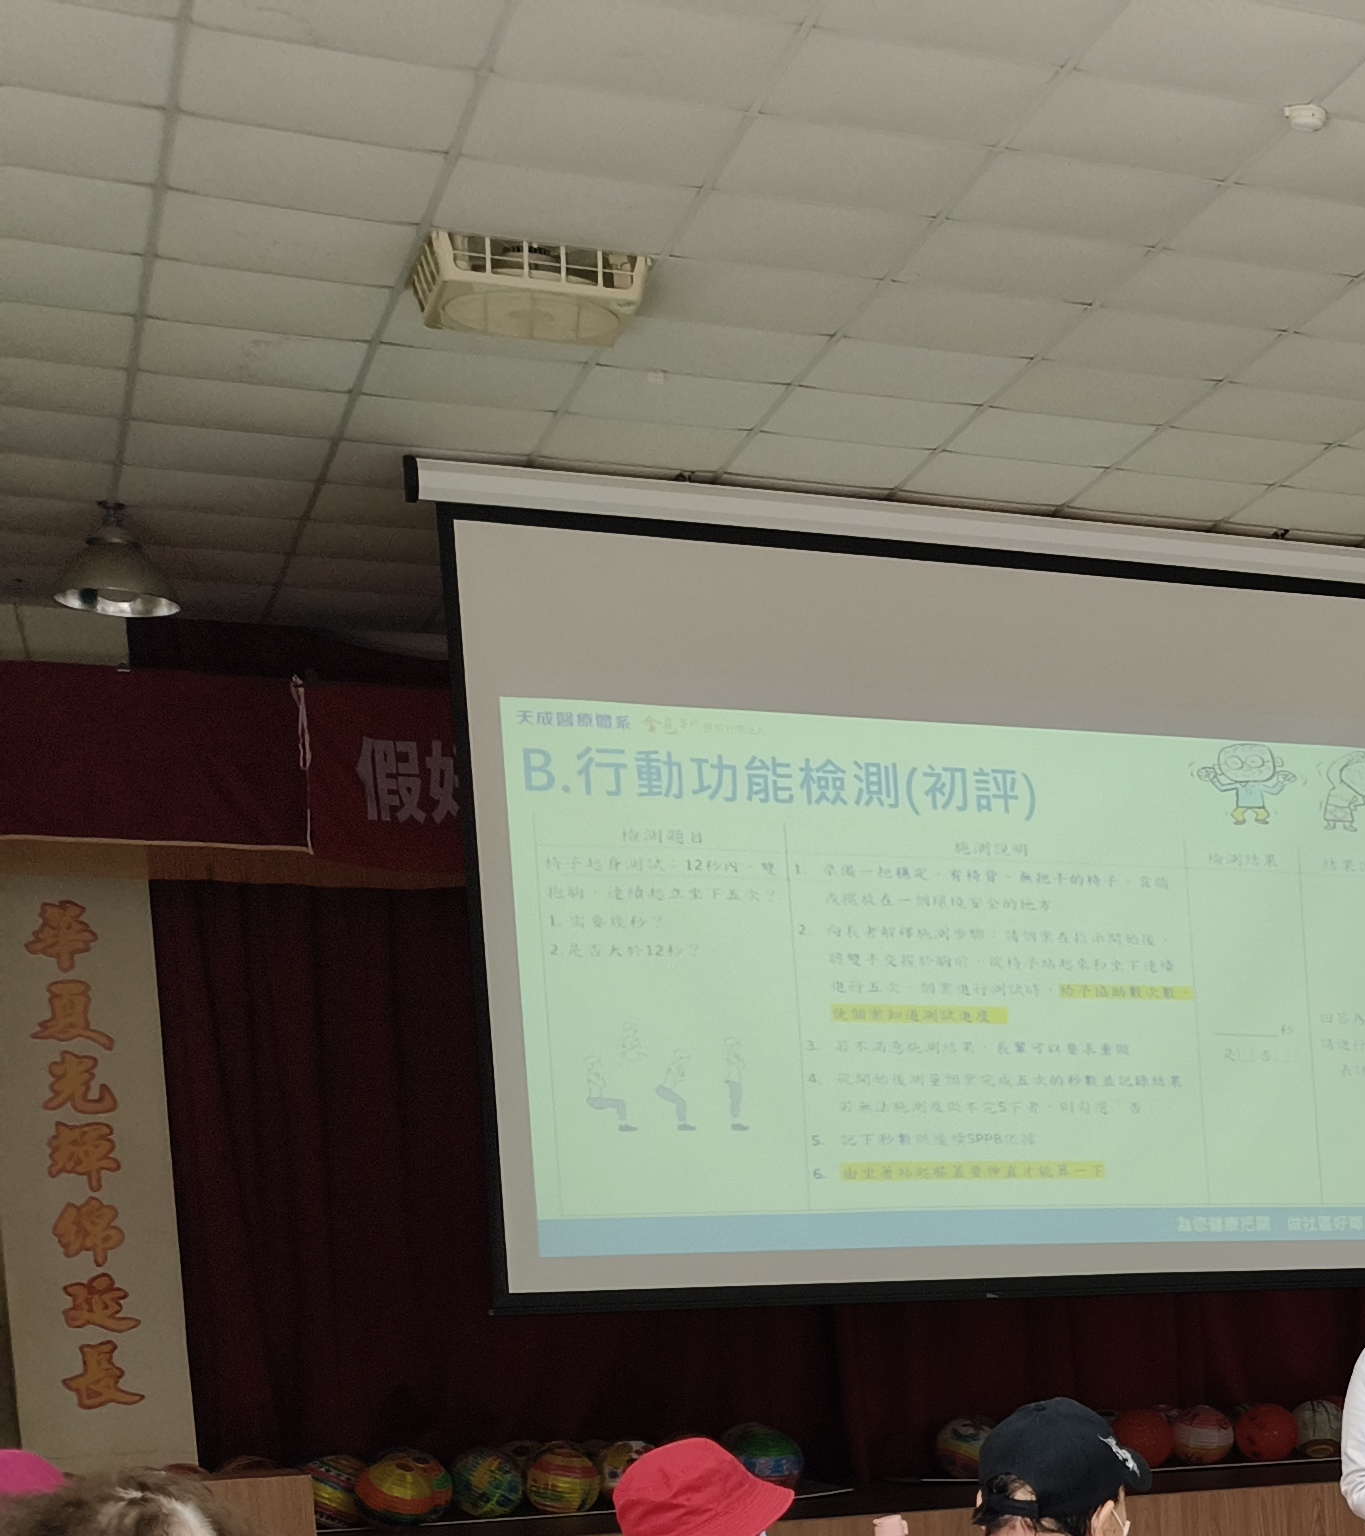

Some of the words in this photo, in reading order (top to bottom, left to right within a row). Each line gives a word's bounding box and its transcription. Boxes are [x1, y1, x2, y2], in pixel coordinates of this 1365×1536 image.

[516, 710, 632, 730] 天成醫療體系
[522, 744, 1037, 822] B.行動功能檢測(初評)
